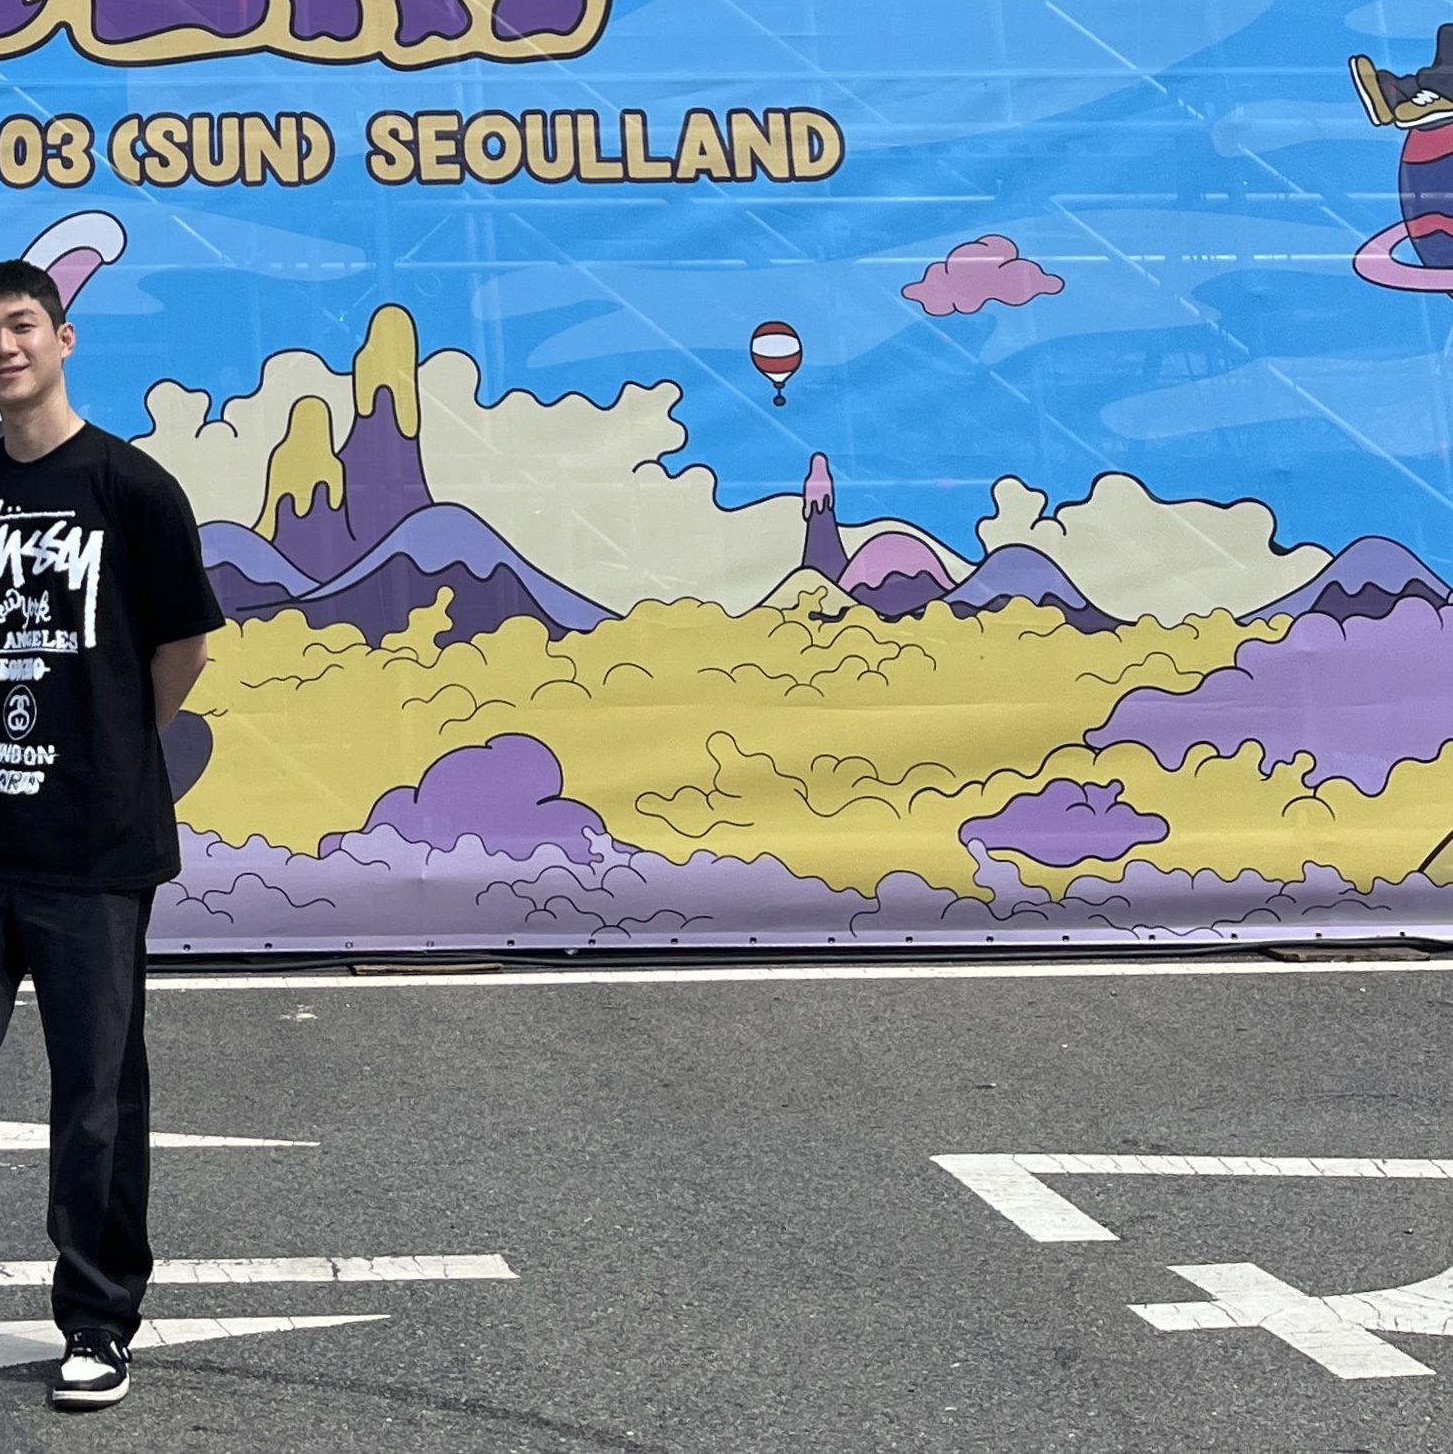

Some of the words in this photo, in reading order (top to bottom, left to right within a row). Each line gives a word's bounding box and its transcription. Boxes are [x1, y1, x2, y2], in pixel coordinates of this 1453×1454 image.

[110, 112, 334, 187] (SUN)
[366, 108, 846, 186] SEOULLAND
[3, 628, 78, 650] ANGELES
